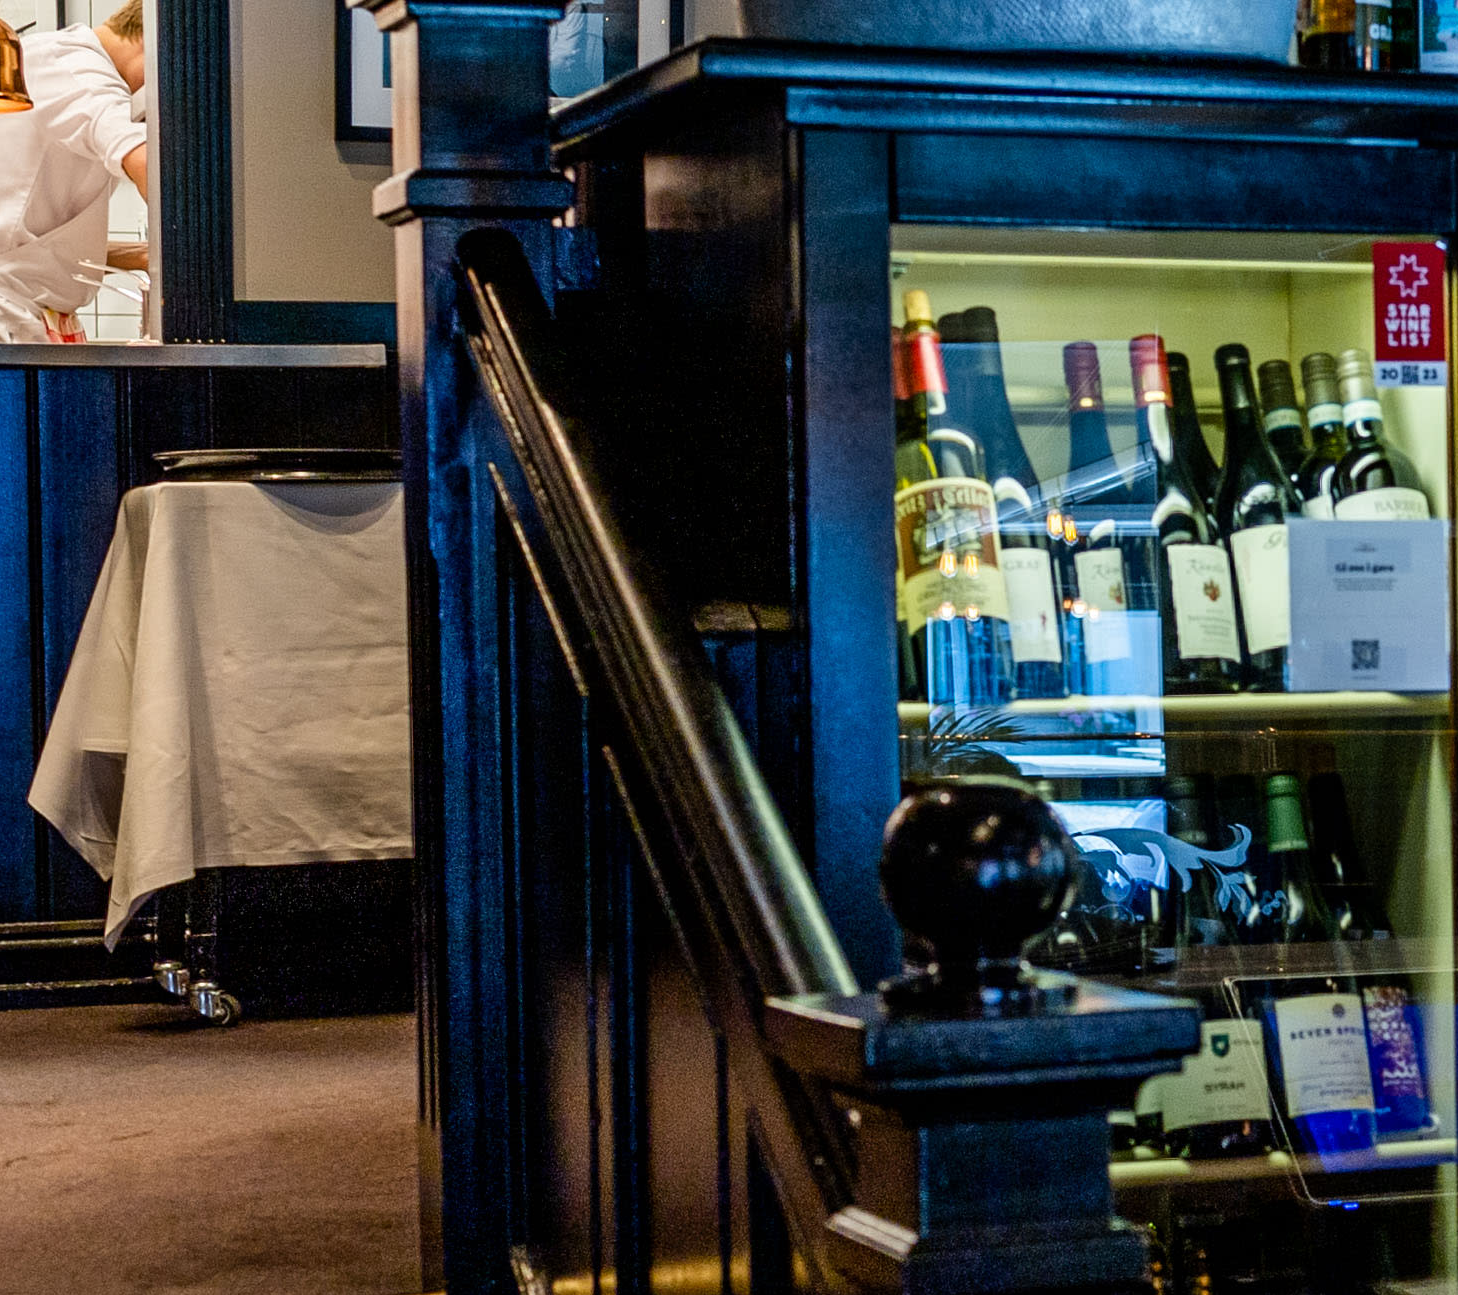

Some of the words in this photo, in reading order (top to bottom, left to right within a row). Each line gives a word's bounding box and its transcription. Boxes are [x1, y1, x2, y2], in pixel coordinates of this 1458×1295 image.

[1387, 303, 1431, 318] STAR
[1384, 318, 1431, 333] WINE
[1387, 332, 1431, 347] LIST
